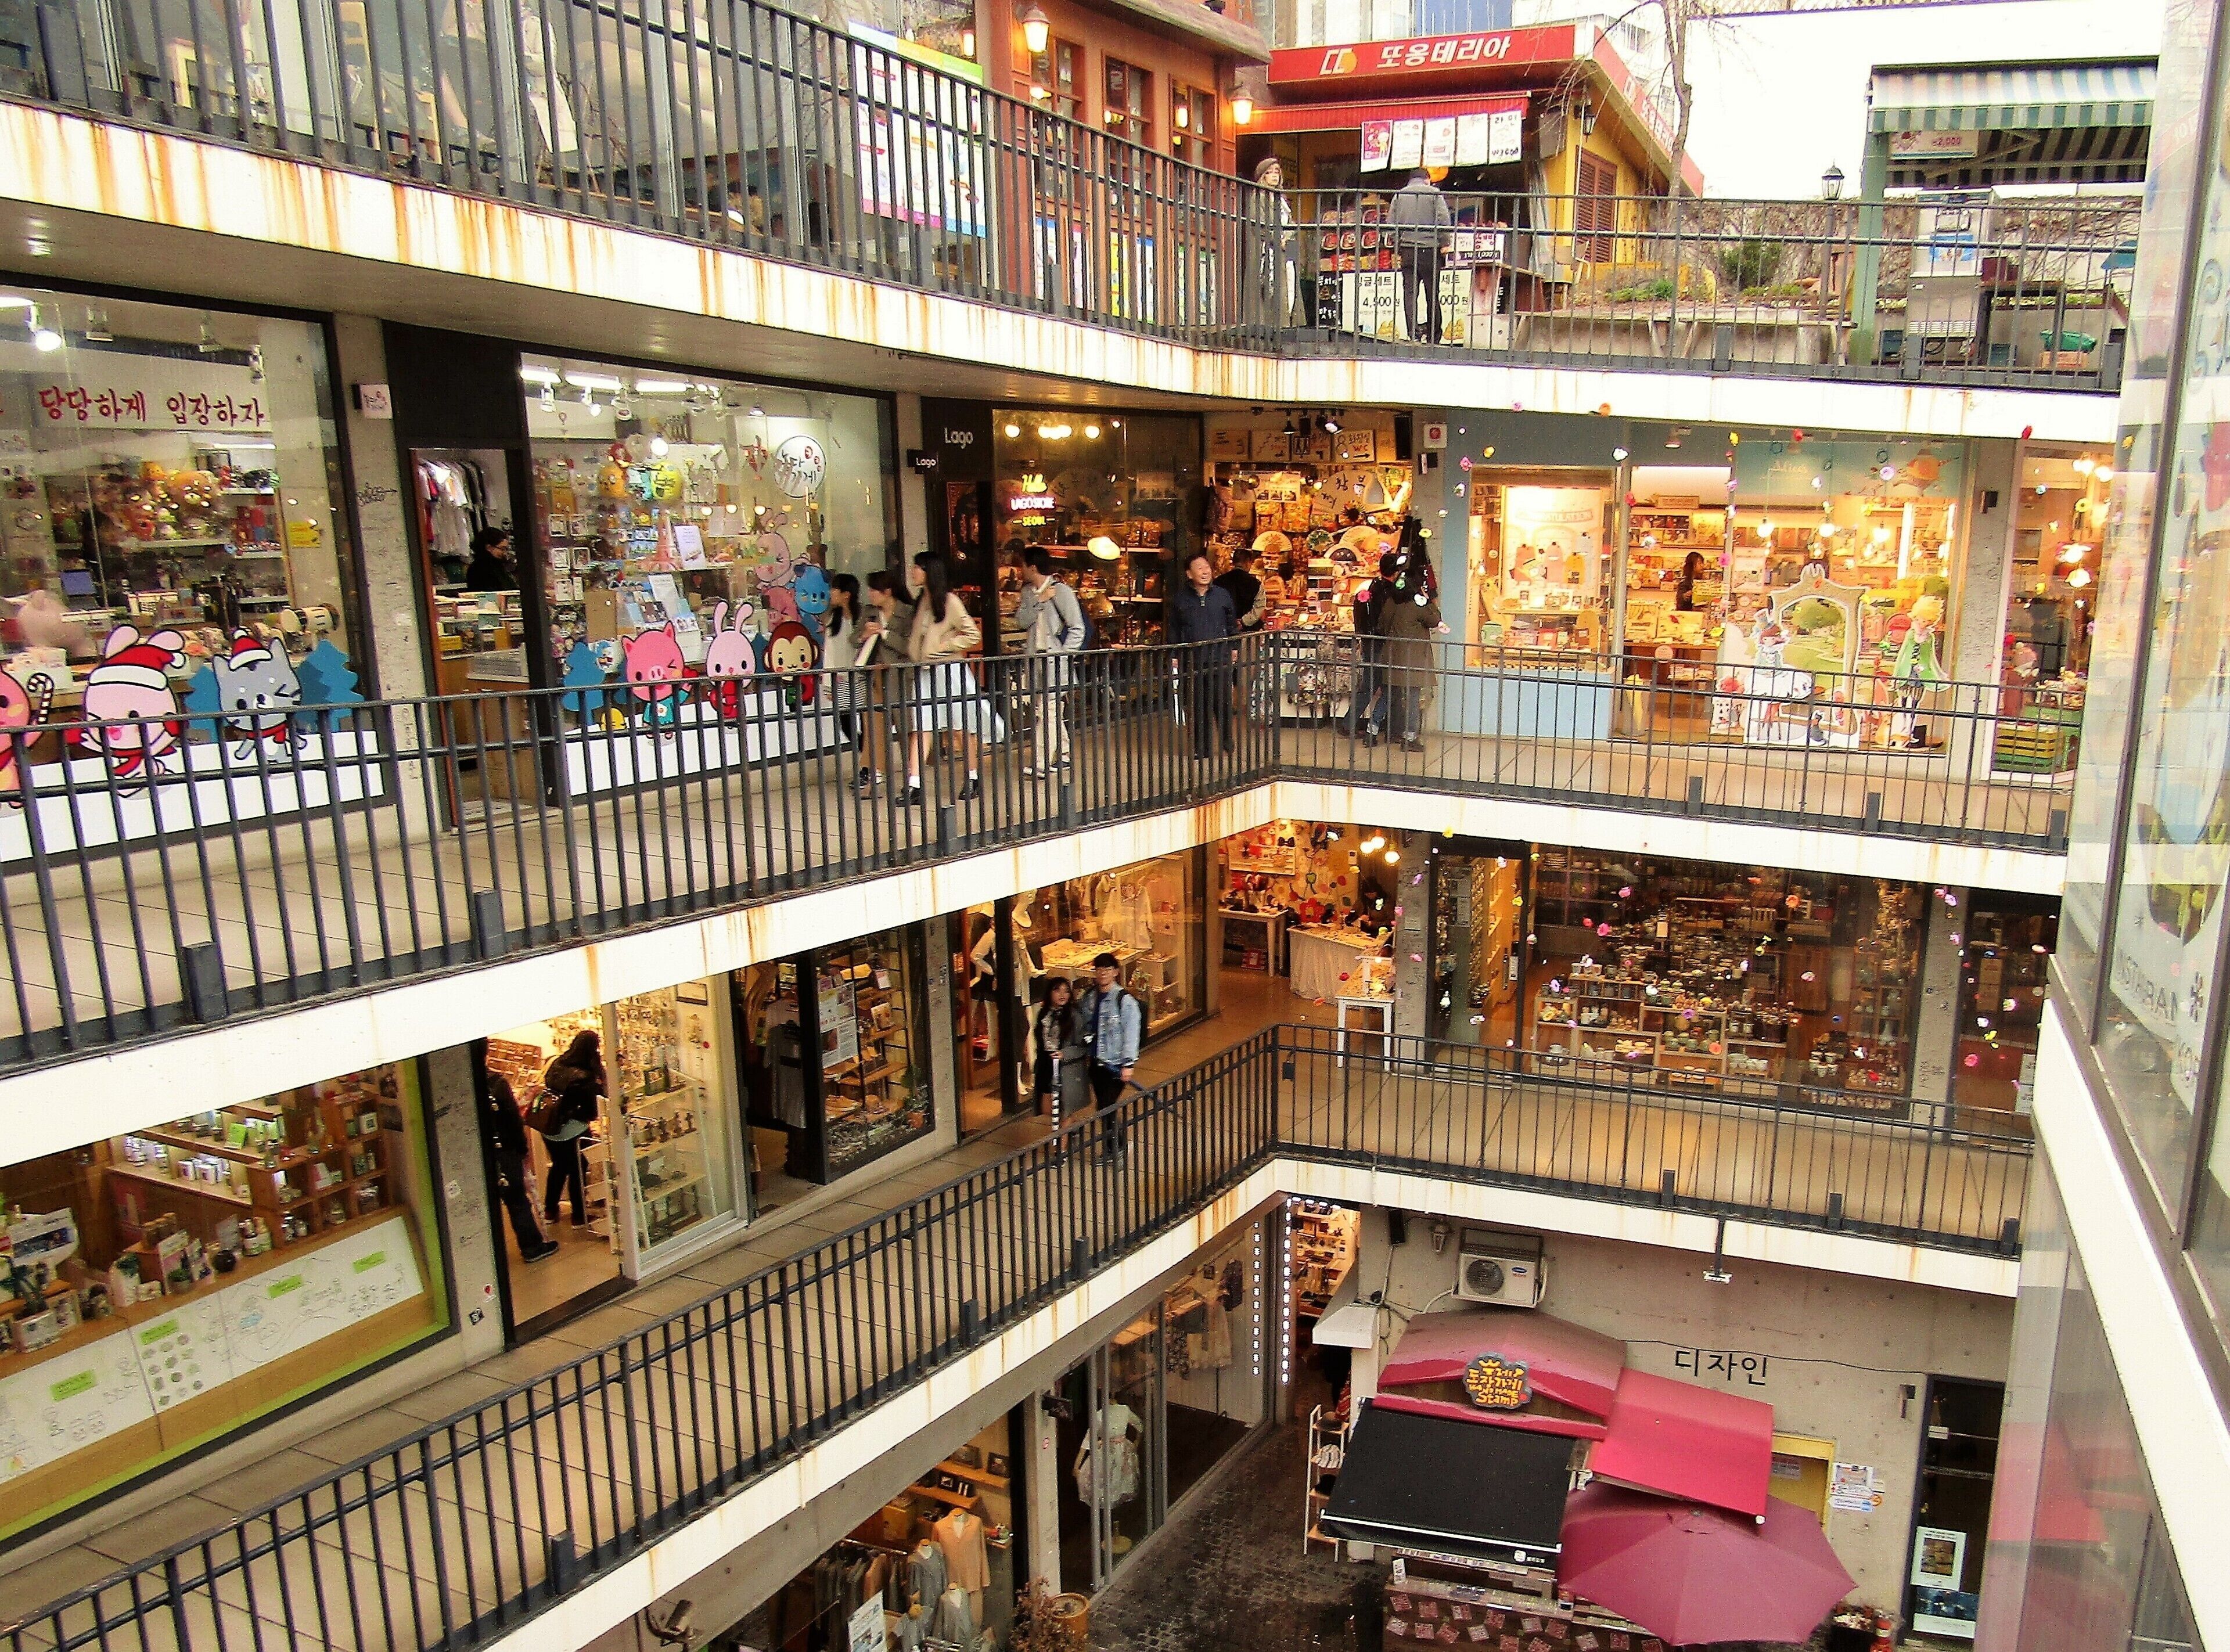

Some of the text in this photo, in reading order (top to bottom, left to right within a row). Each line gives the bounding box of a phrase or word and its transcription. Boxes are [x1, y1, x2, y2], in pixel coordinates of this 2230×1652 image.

[1376, 35, 1511, 69] 또옹테리아
[39, 386, 265, 427] 당당하게 입장하자
[944, 427, 973, 449] Lago
[916, 458, 937, 468] Lago
[1022, 516, 1046, 527] SEOUL
[1675, 1349, 1766, 1386] 디자인
[1476, 1391, 1519, 1406] Stamp
